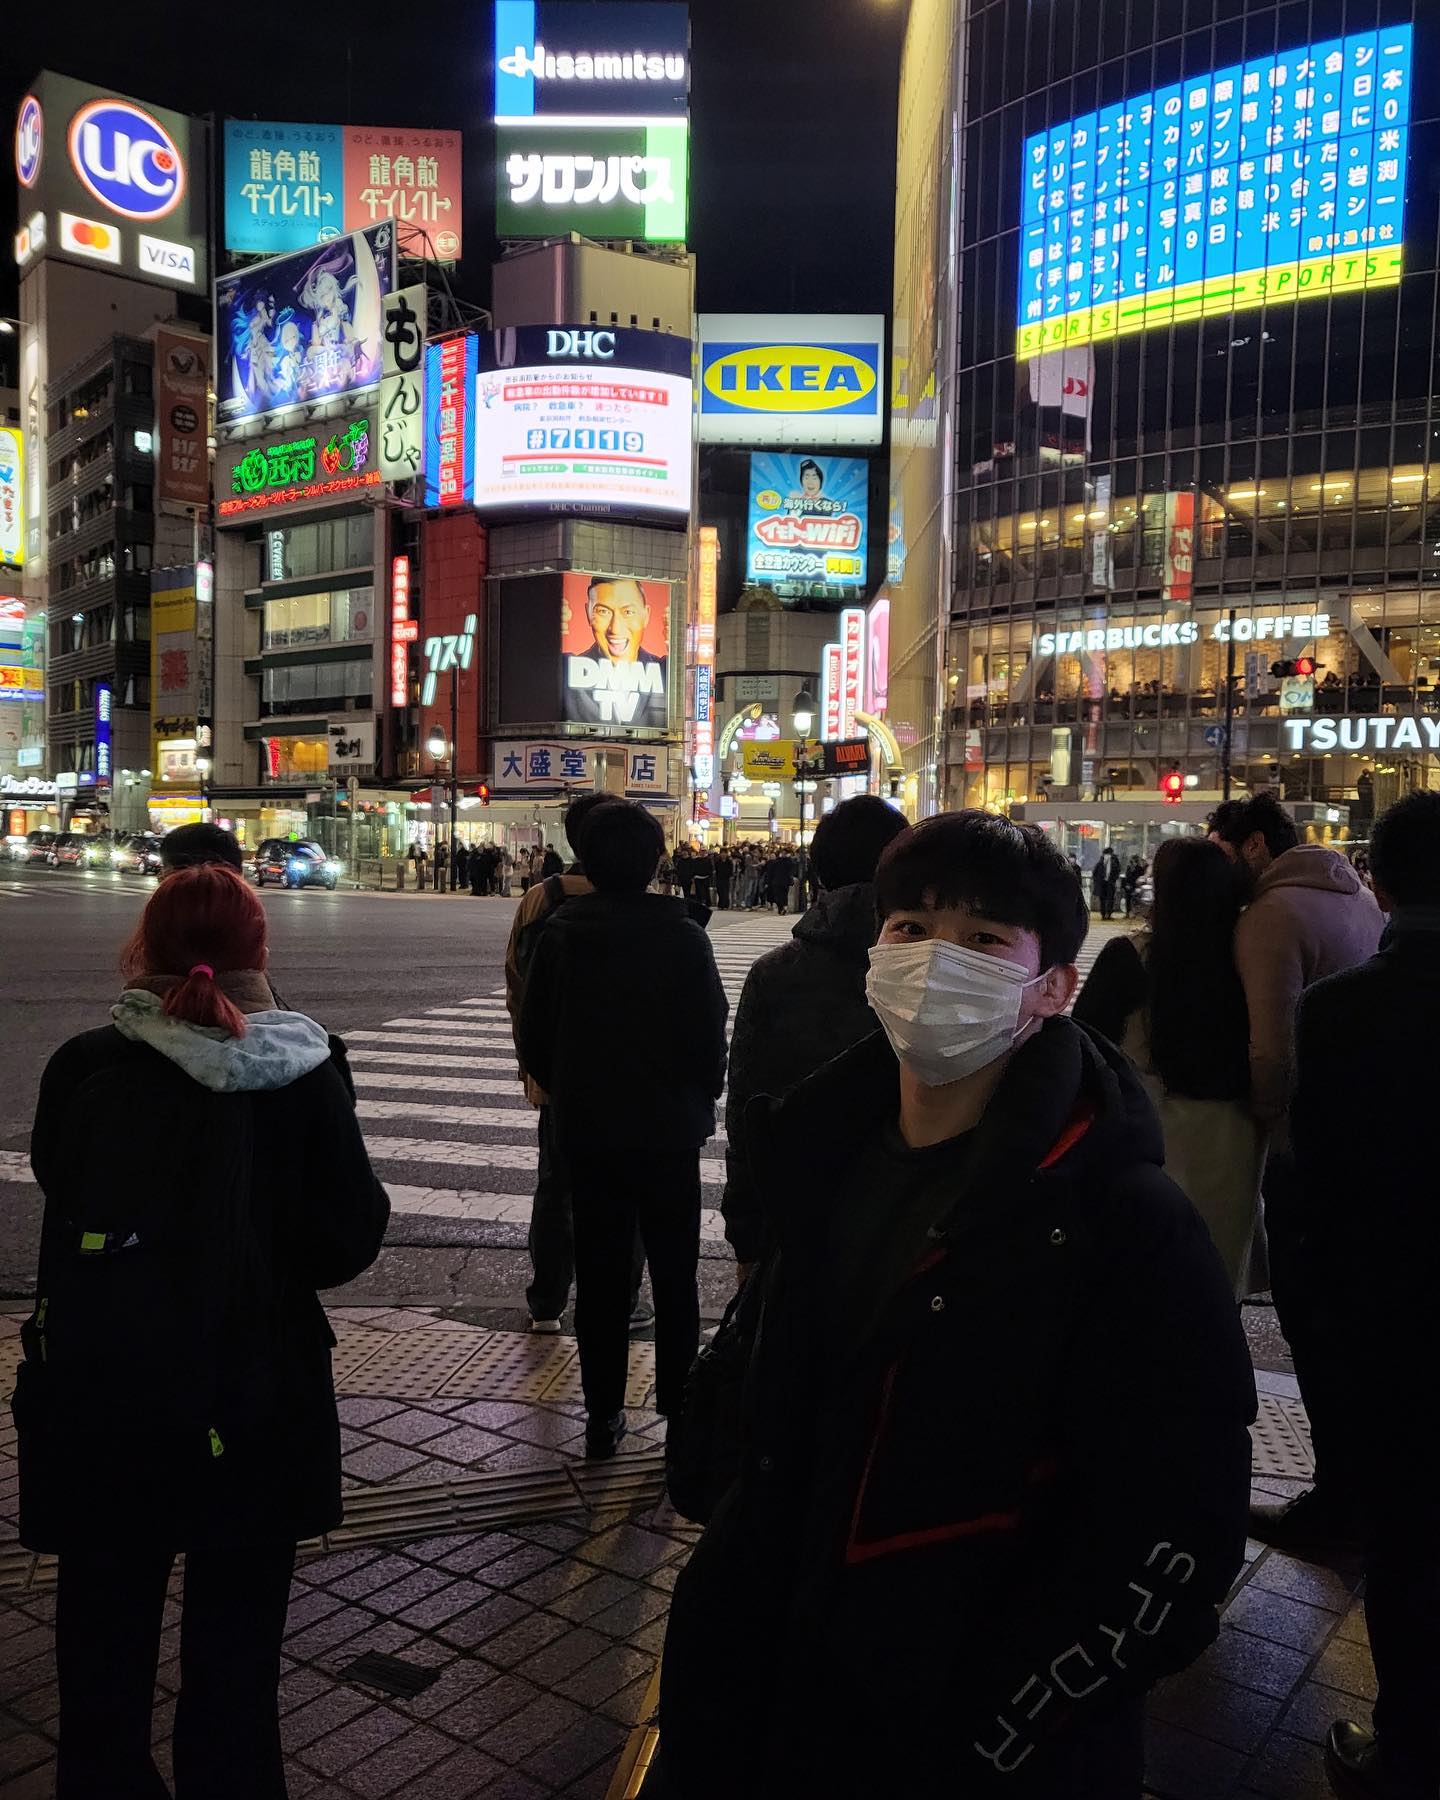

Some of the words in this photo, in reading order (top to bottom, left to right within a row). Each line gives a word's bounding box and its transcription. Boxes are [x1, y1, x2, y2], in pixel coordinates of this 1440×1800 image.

[499, 45, 685, 80] Hisamitsu
[248, 148, 321, 183] 龍角散
[368, 153, 439, 188] 龍角散
[505, 154, 675, 205] サロンパス
[240, 183, 335, 218] ダイレクト
[359, 188, 452, 221] ダイレクト
[1307, 224, 1394, 252] 時事通信社
[146, 245, 192, 272] VISA
[1256, 256, 1378, 295] SPORTS
[1027, 263, 1175, 319] 州ナッシュビル
[546, 330, 616, 360] DHC
[1023, 309, 1112, 349] SPORTS
[384, 294, 423, 472] もんじゃ
[720, 364, 863, 391] IKEA
[528, 430, 643, 453] #7119
[549, 502, 570, 512] DHC
[573, 503, 611, 514] Channel
[1039, 620, 1199, 656] STARBUCKS
[1213, 612, 1330, 643] COFFEE
[422, 613, 478, 707] クスリ
[567, 655, 665, 694] DMM
[592, 689, 641, 726] TV
[503, 749, 657, 782] 大盛堂店
[974, 1541, 1197, 1773] SPYDER
